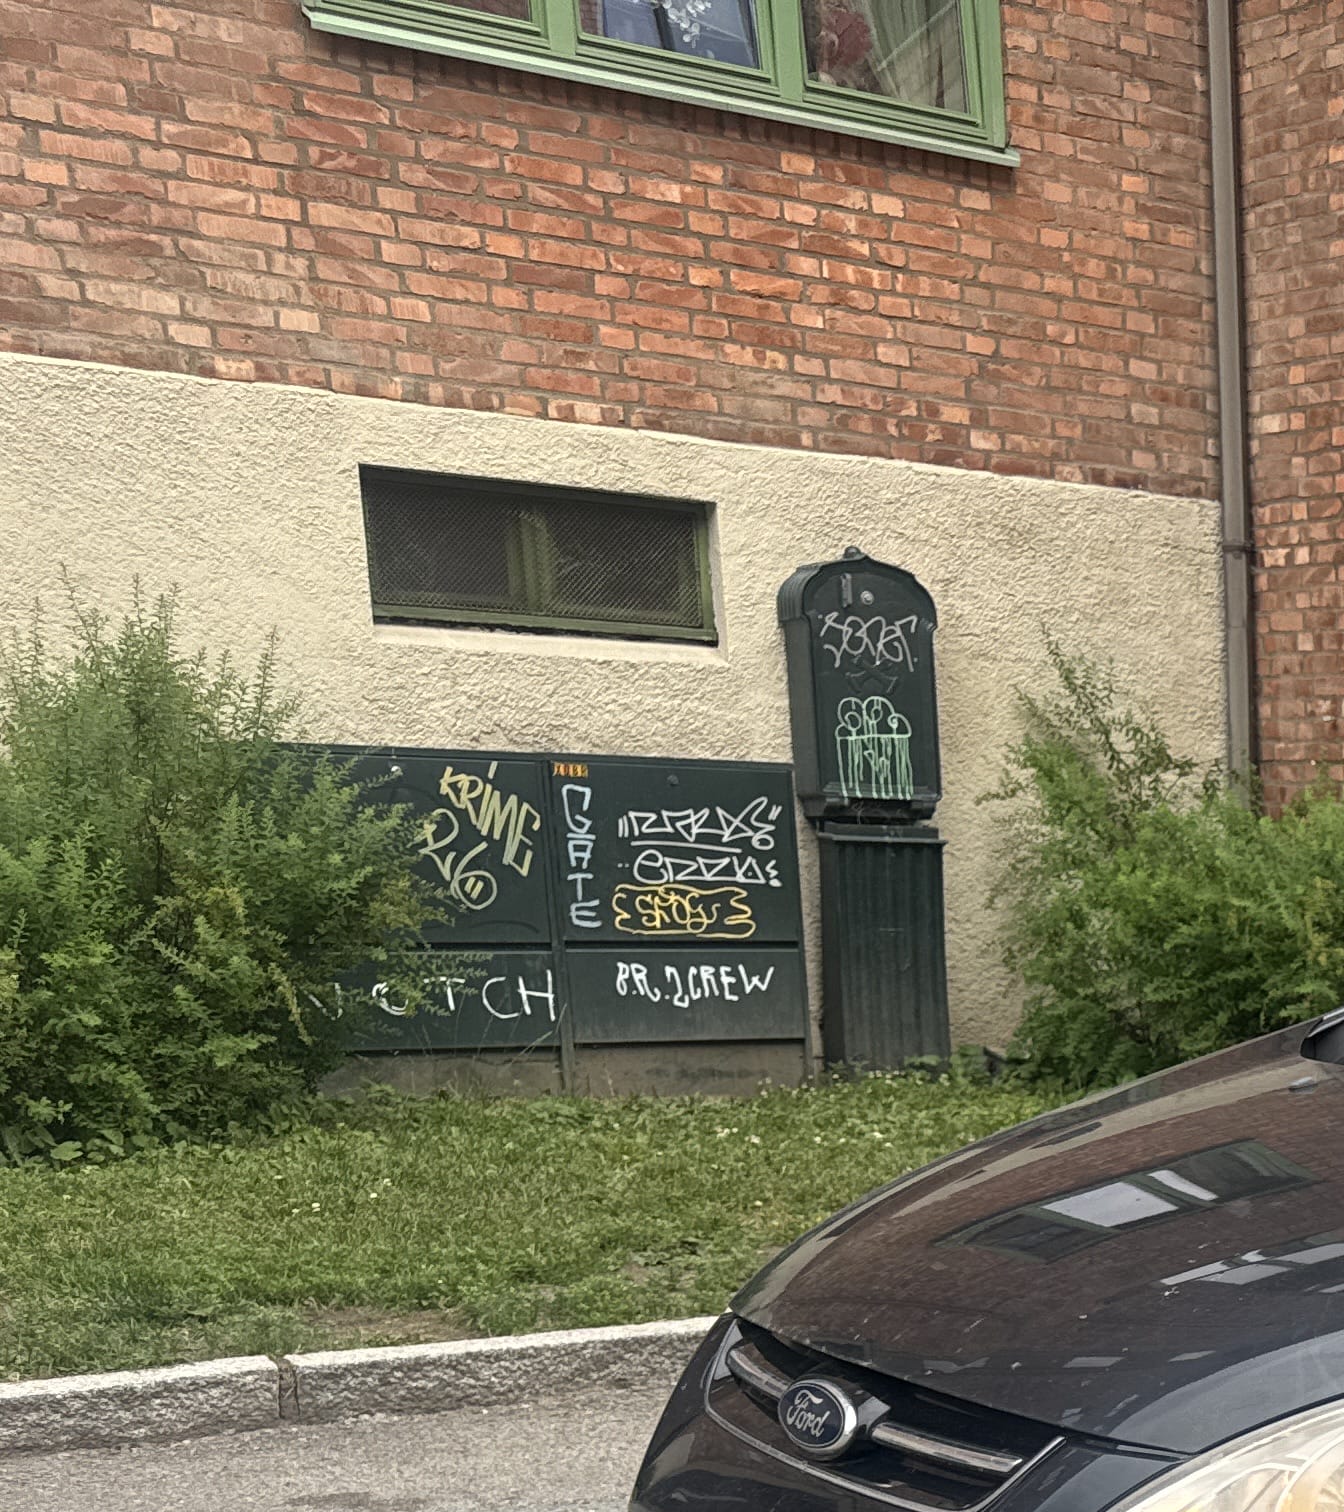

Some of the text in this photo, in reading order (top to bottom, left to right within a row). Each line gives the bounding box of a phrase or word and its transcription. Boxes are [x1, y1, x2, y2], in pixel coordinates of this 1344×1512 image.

[440, 761, 541, 877] KRIME
[561, 784, 603, 929] GATE
[786, 1389, 831, 1438] Ford
